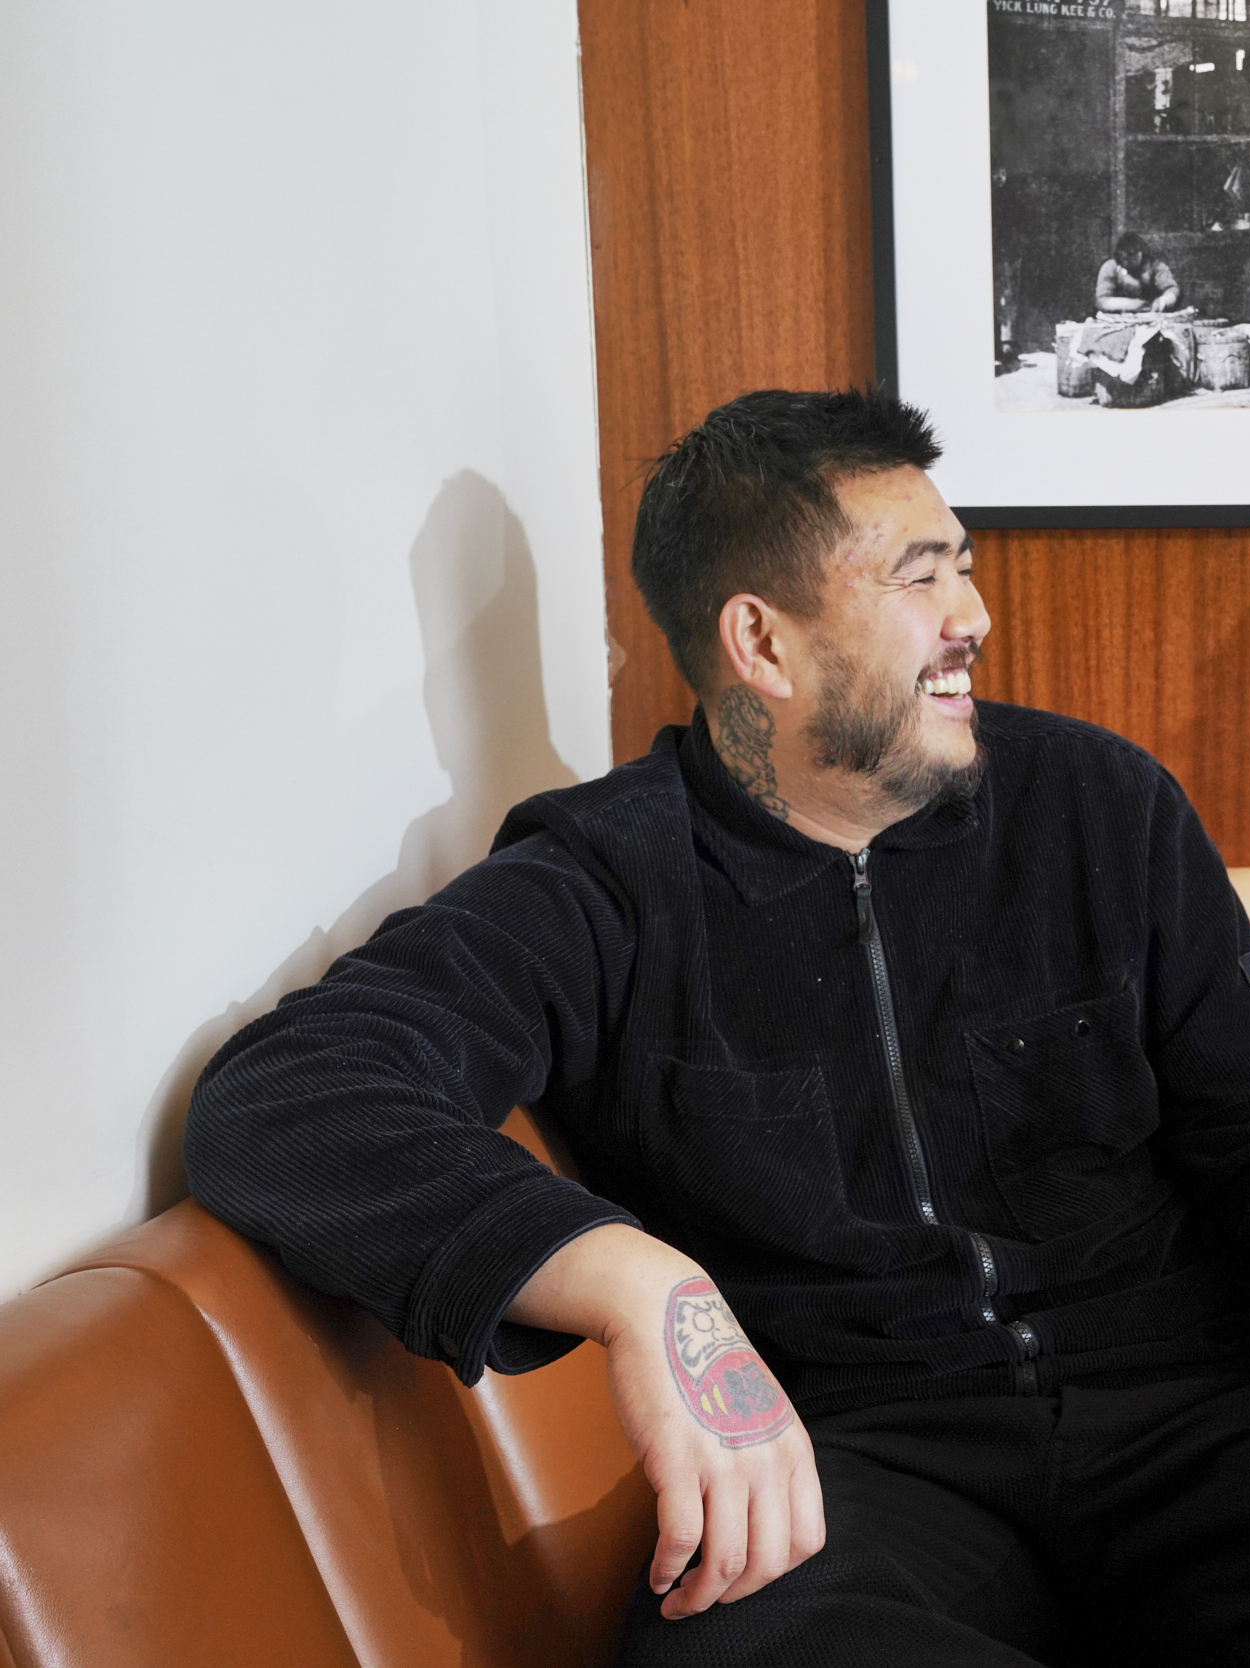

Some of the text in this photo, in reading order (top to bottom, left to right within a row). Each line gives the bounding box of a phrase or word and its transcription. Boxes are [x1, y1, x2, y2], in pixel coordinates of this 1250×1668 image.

[993, 0, 1022, 12] YICK
[1026, 3, 1058, 15] LUNG
[1061, 4, 1084, 17] KEE
[1087, 6, 1096, 17] &
